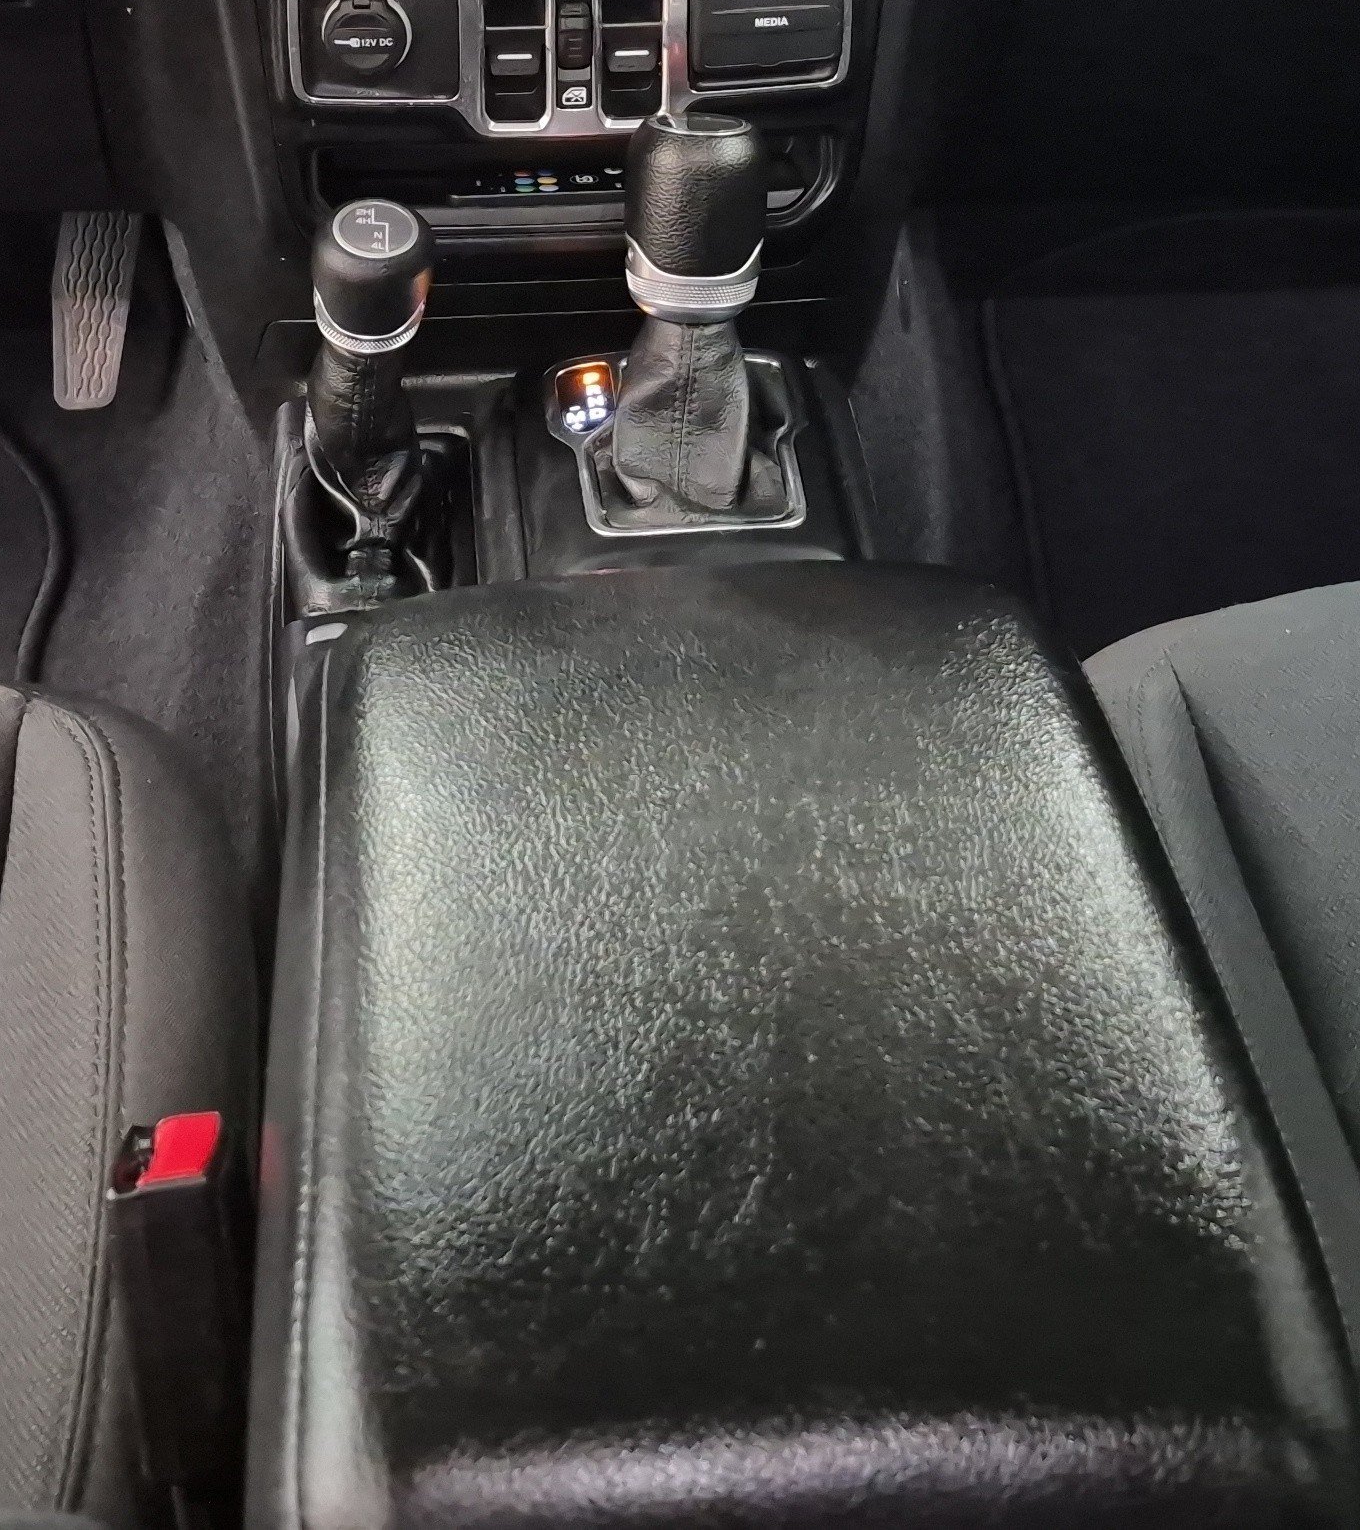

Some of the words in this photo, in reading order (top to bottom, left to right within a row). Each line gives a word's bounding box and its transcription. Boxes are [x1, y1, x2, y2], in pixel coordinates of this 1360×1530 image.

[754, 16, 789, 28] MEDIA
[361, 38, 377, 47] 12V
[379, 38, 394, 47] DC
[373, 231, 383, 239] N
[370, 241, 384, 250] 4L
